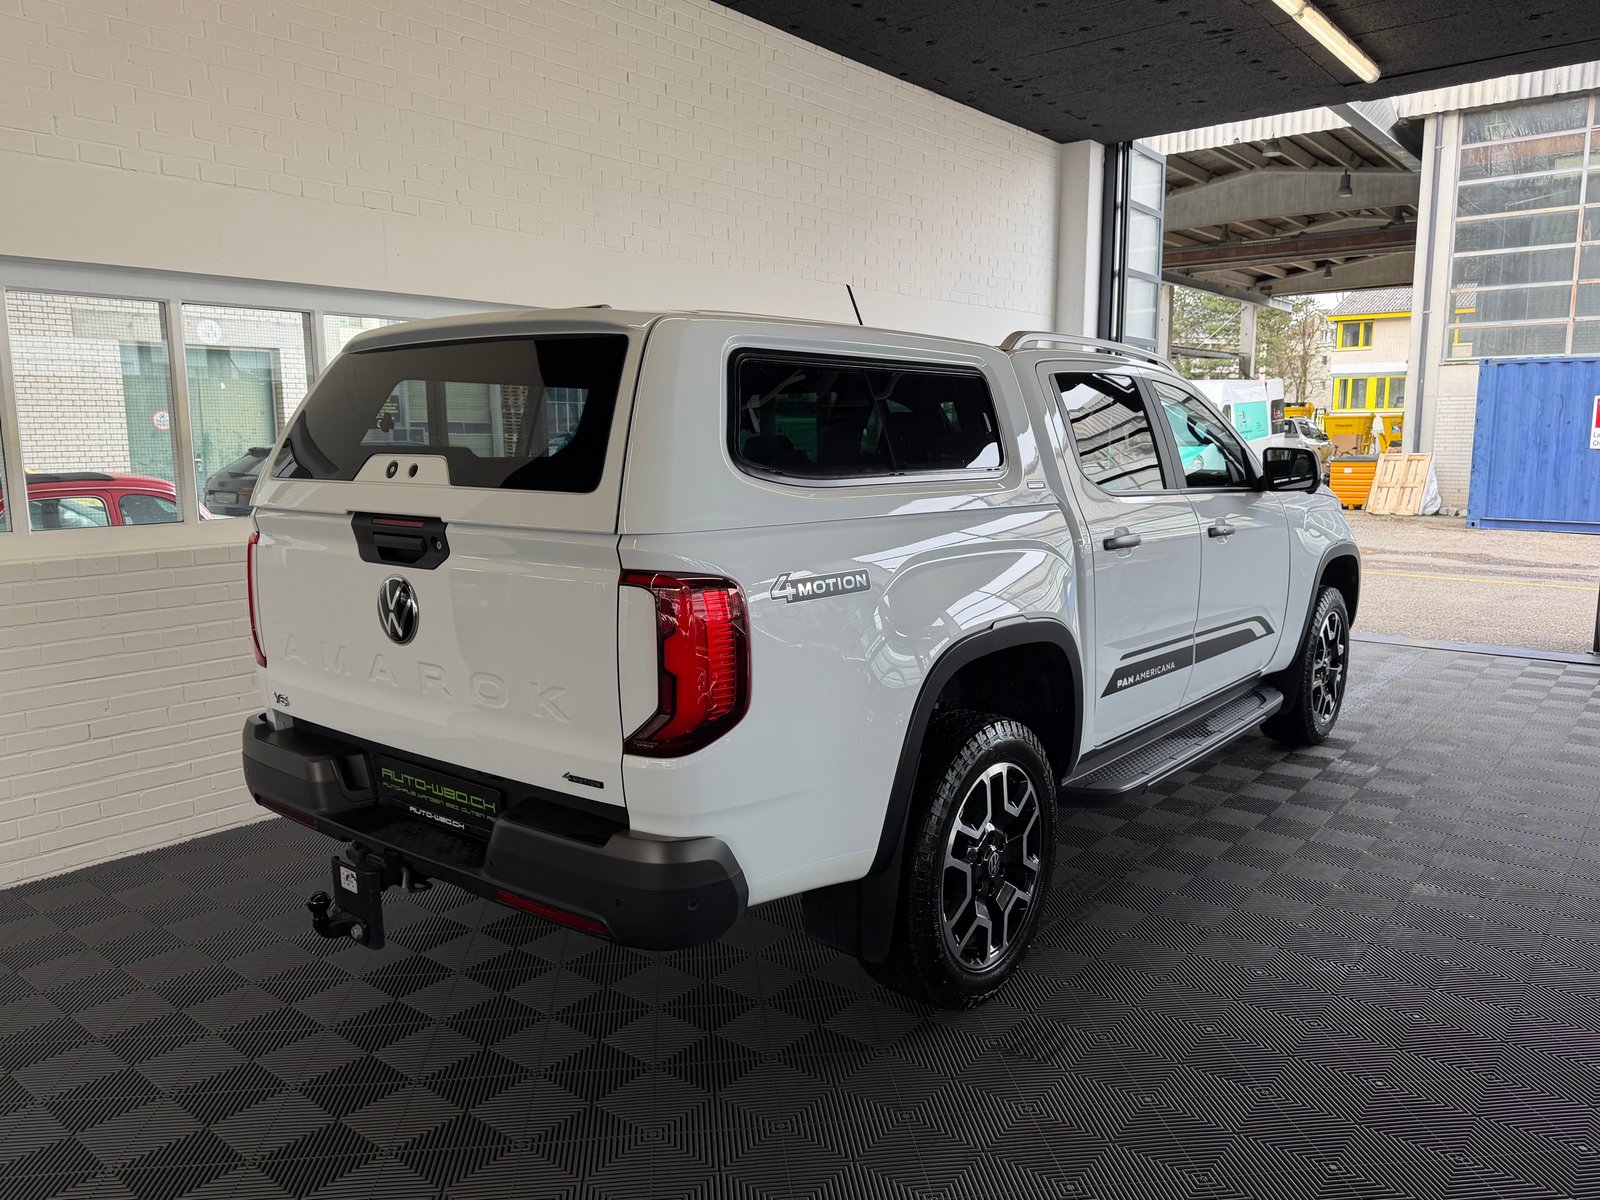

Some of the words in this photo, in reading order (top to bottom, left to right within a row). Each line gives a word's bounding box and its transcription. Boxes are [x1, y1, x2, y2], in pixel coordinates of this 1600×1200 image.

[284, 633, 572, 724] AMAROK
[1117, 675, 1134, 688] PAN
[1135, 661, 1175, 682] AMERICANA
